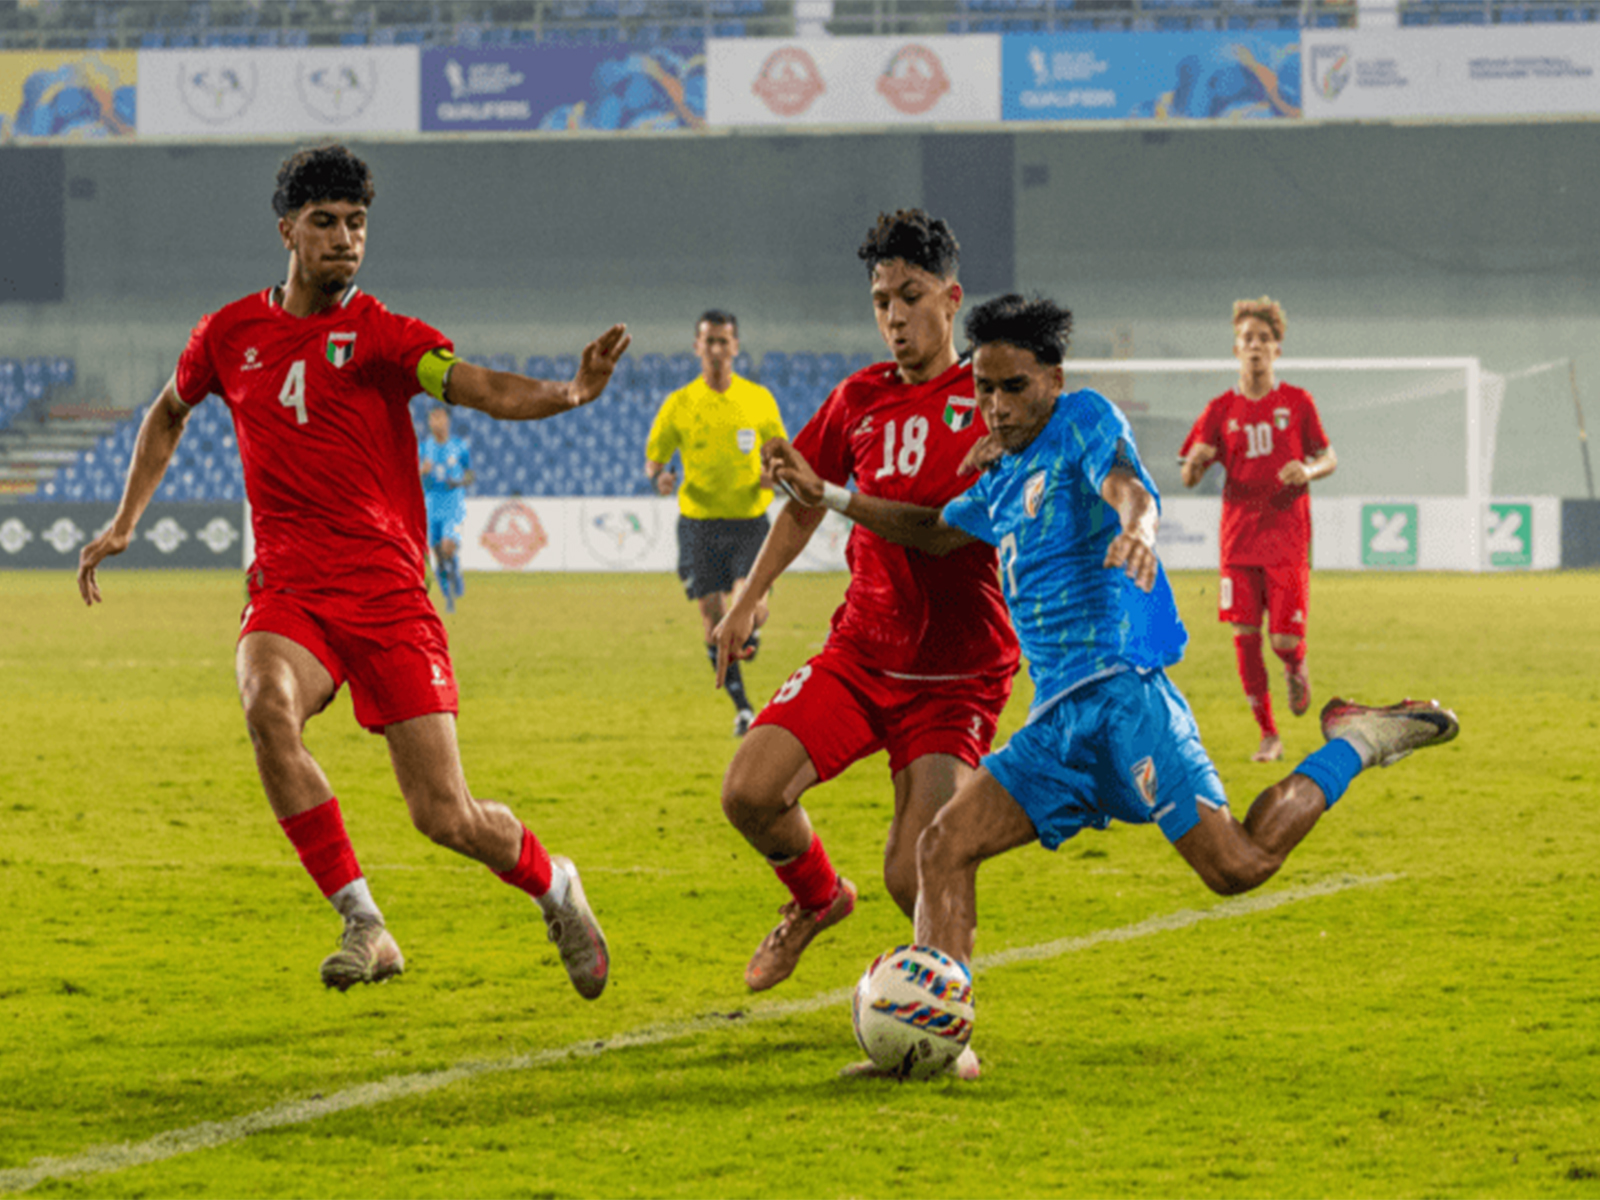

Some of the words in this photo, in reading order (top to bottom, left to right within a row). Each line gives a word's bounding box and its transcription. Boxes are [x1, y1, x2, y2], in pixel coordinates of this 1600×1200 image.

[278, 360, 308, 424] 4
[875, 414, 929, 480] 18
[1243, 422, 1273, 458] 10
